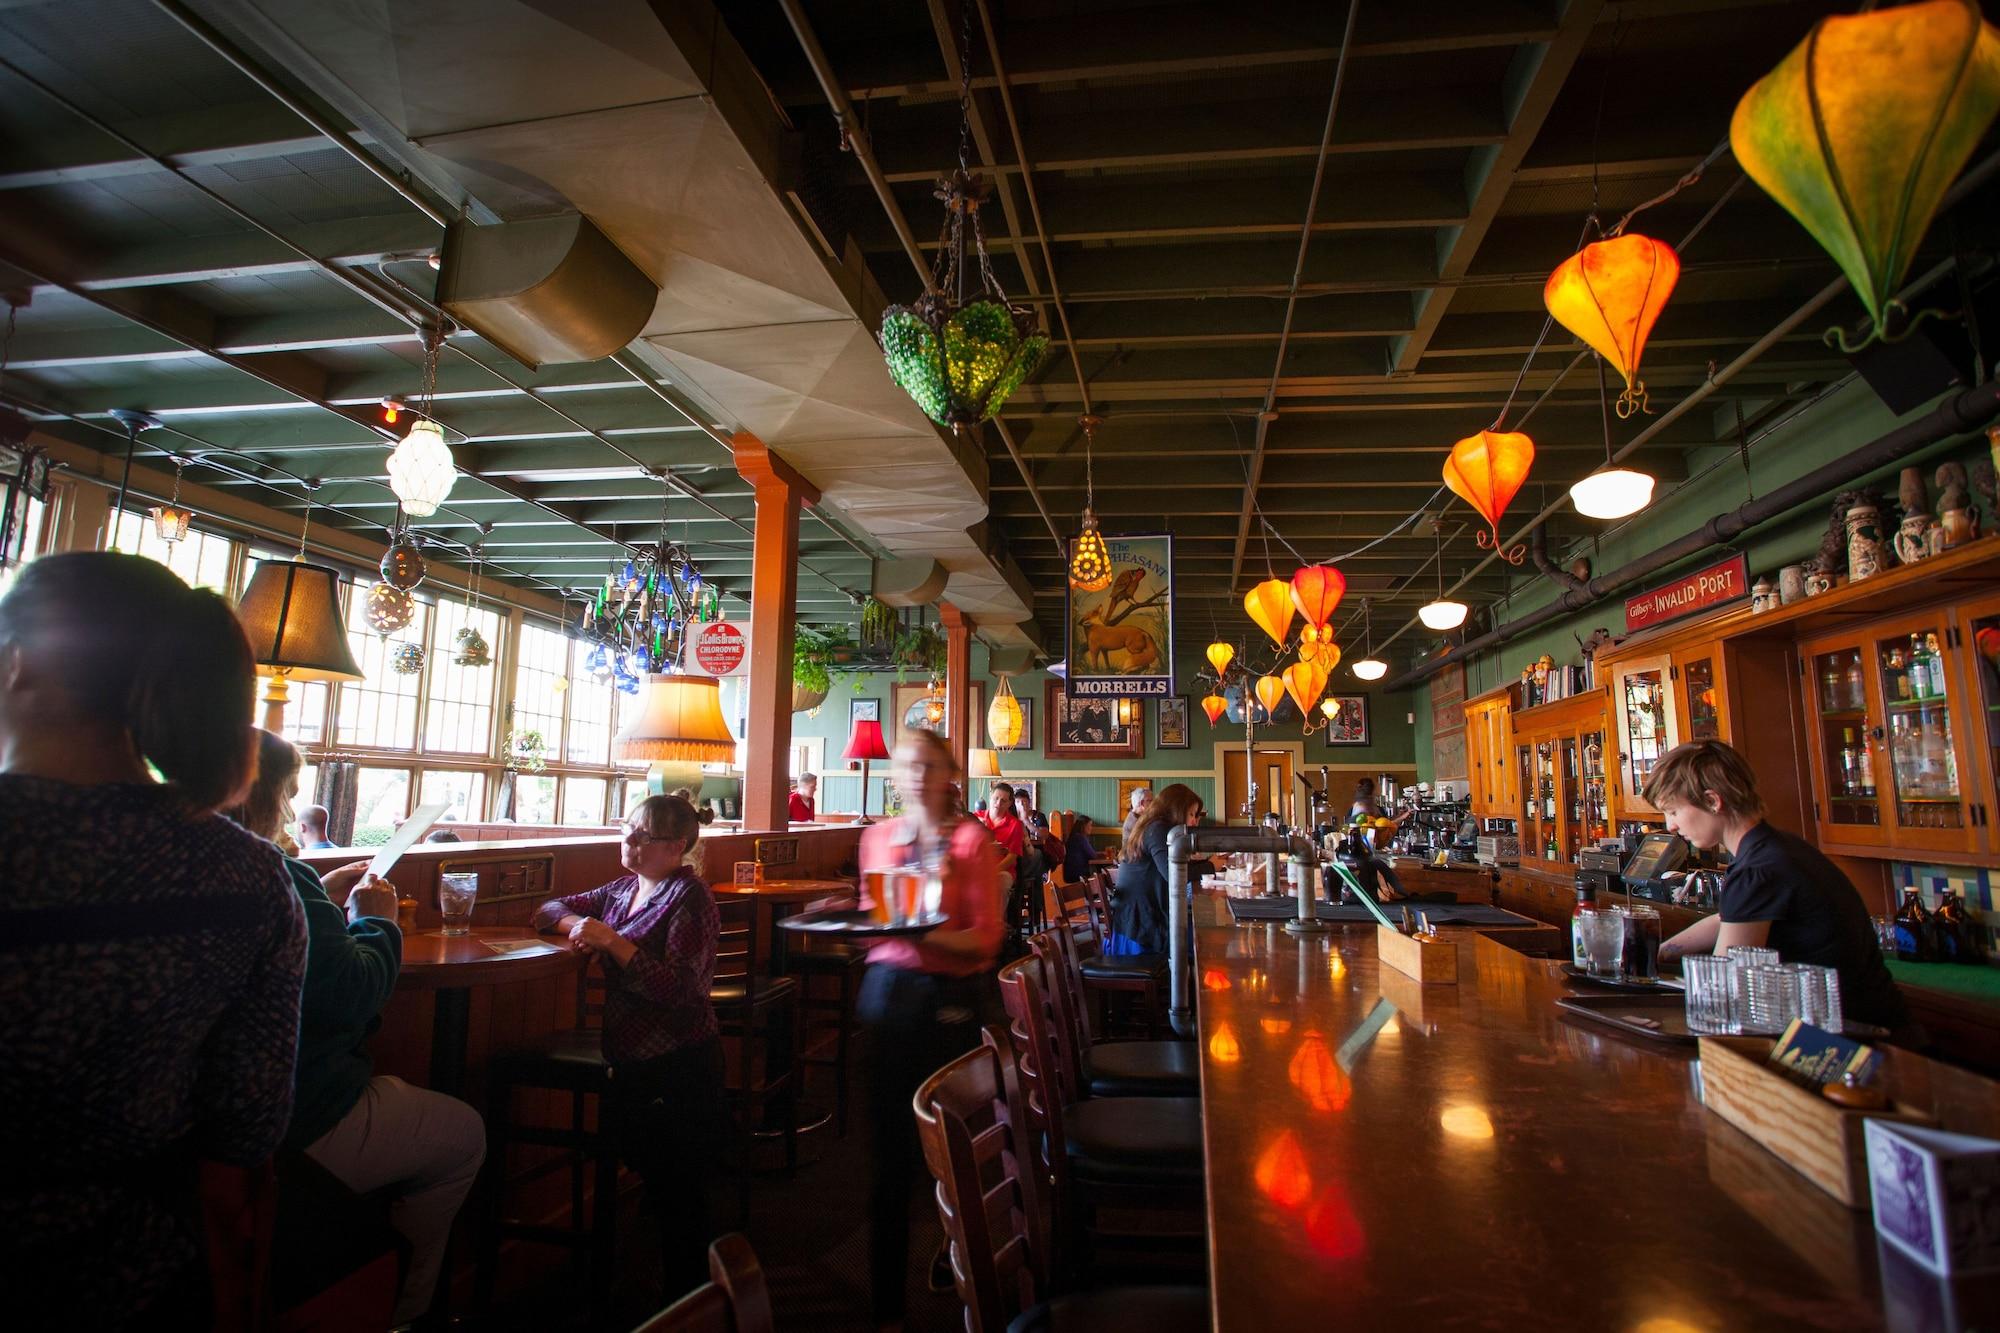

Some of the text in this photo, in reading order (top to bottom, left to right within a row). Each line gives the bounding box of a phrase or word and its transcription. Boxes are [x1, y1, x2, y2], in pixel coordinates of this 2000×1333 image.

[1110, 543, 1129, 552] The
[1655, 585, 1696, 613] INVALID
[1699, 570, 1733, 597] PORT
[1075, 681, 1167, 694] MORRELLS
